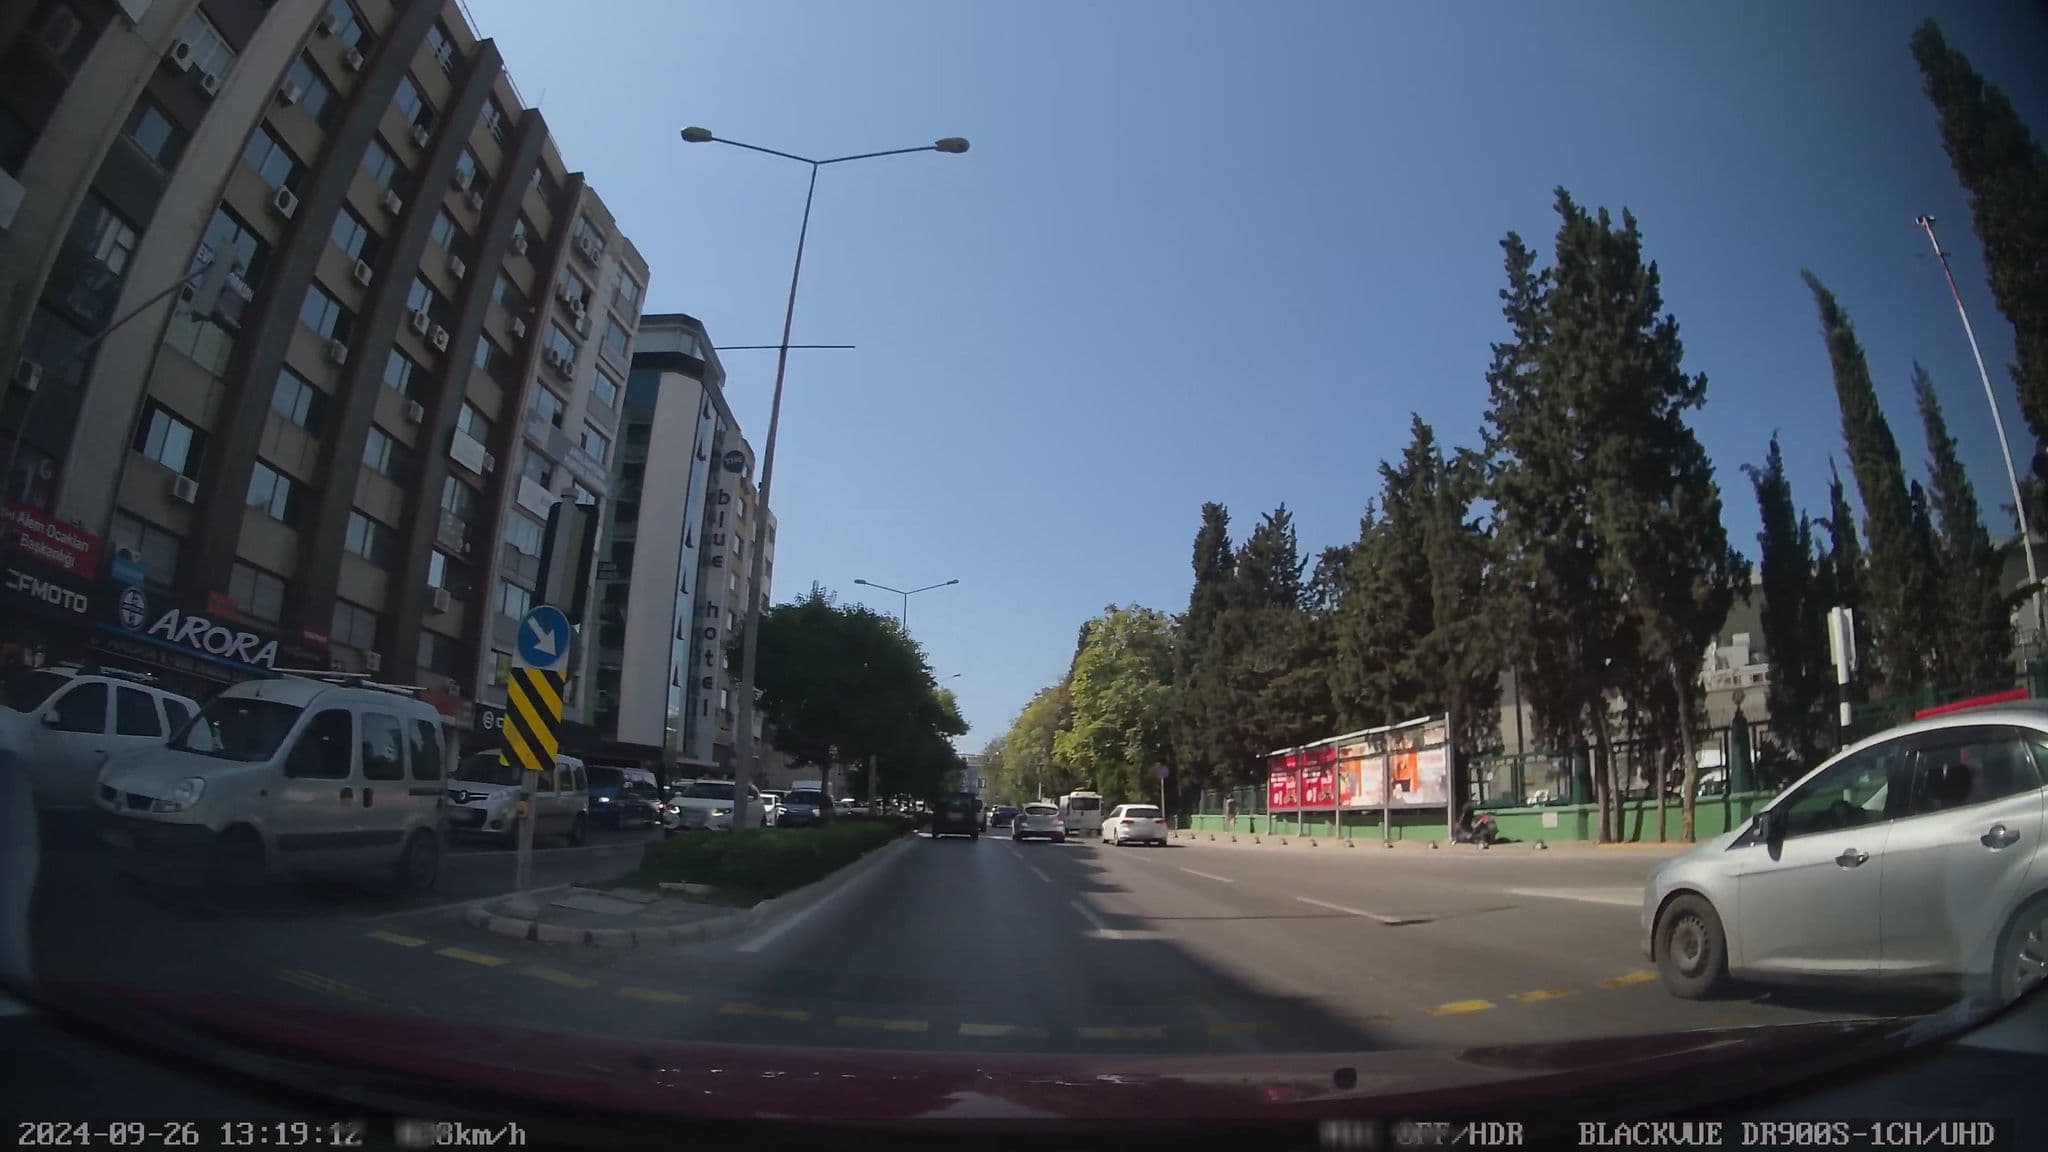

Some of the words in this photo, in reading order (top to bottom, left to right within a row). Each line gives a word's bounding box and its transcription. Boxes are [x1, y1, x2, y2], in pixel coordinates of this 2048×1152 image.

[711, 488, 731, 568] blue
[147, 608, 279, 669] ARORA
[702, 600, 719, 717] hotel
